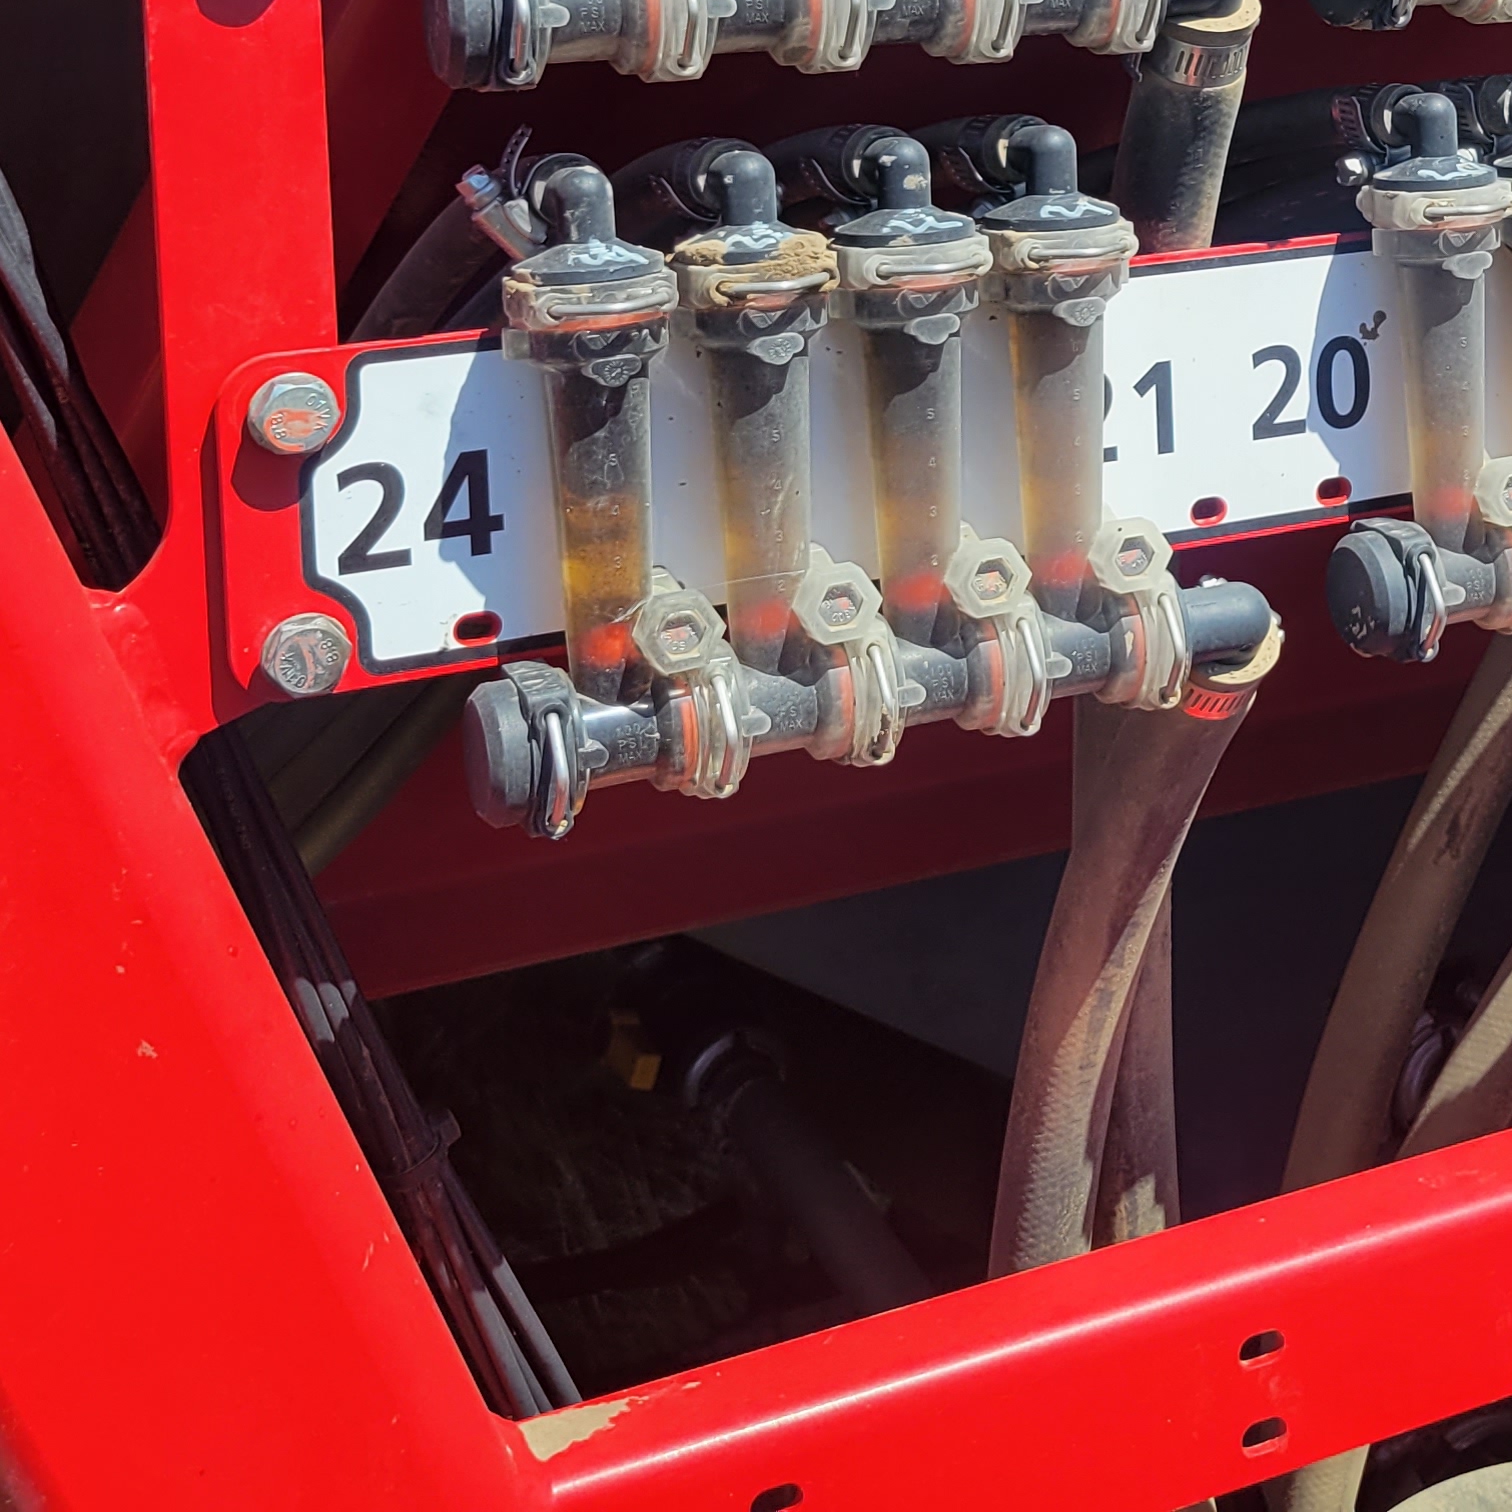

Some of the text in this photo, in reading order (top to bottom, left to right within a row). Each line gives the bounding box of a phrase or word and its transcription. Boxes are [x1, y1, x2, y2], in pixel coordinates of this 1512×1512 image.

[1103, 334, 1372, 464] 1 20
[926, 408, 935, 419] 5
[928, 456, 937, 469] 4
[335, 448, 506, 577] 24
[929, 506, 938, 518] 3
[930, 554, 939, 566] 2
